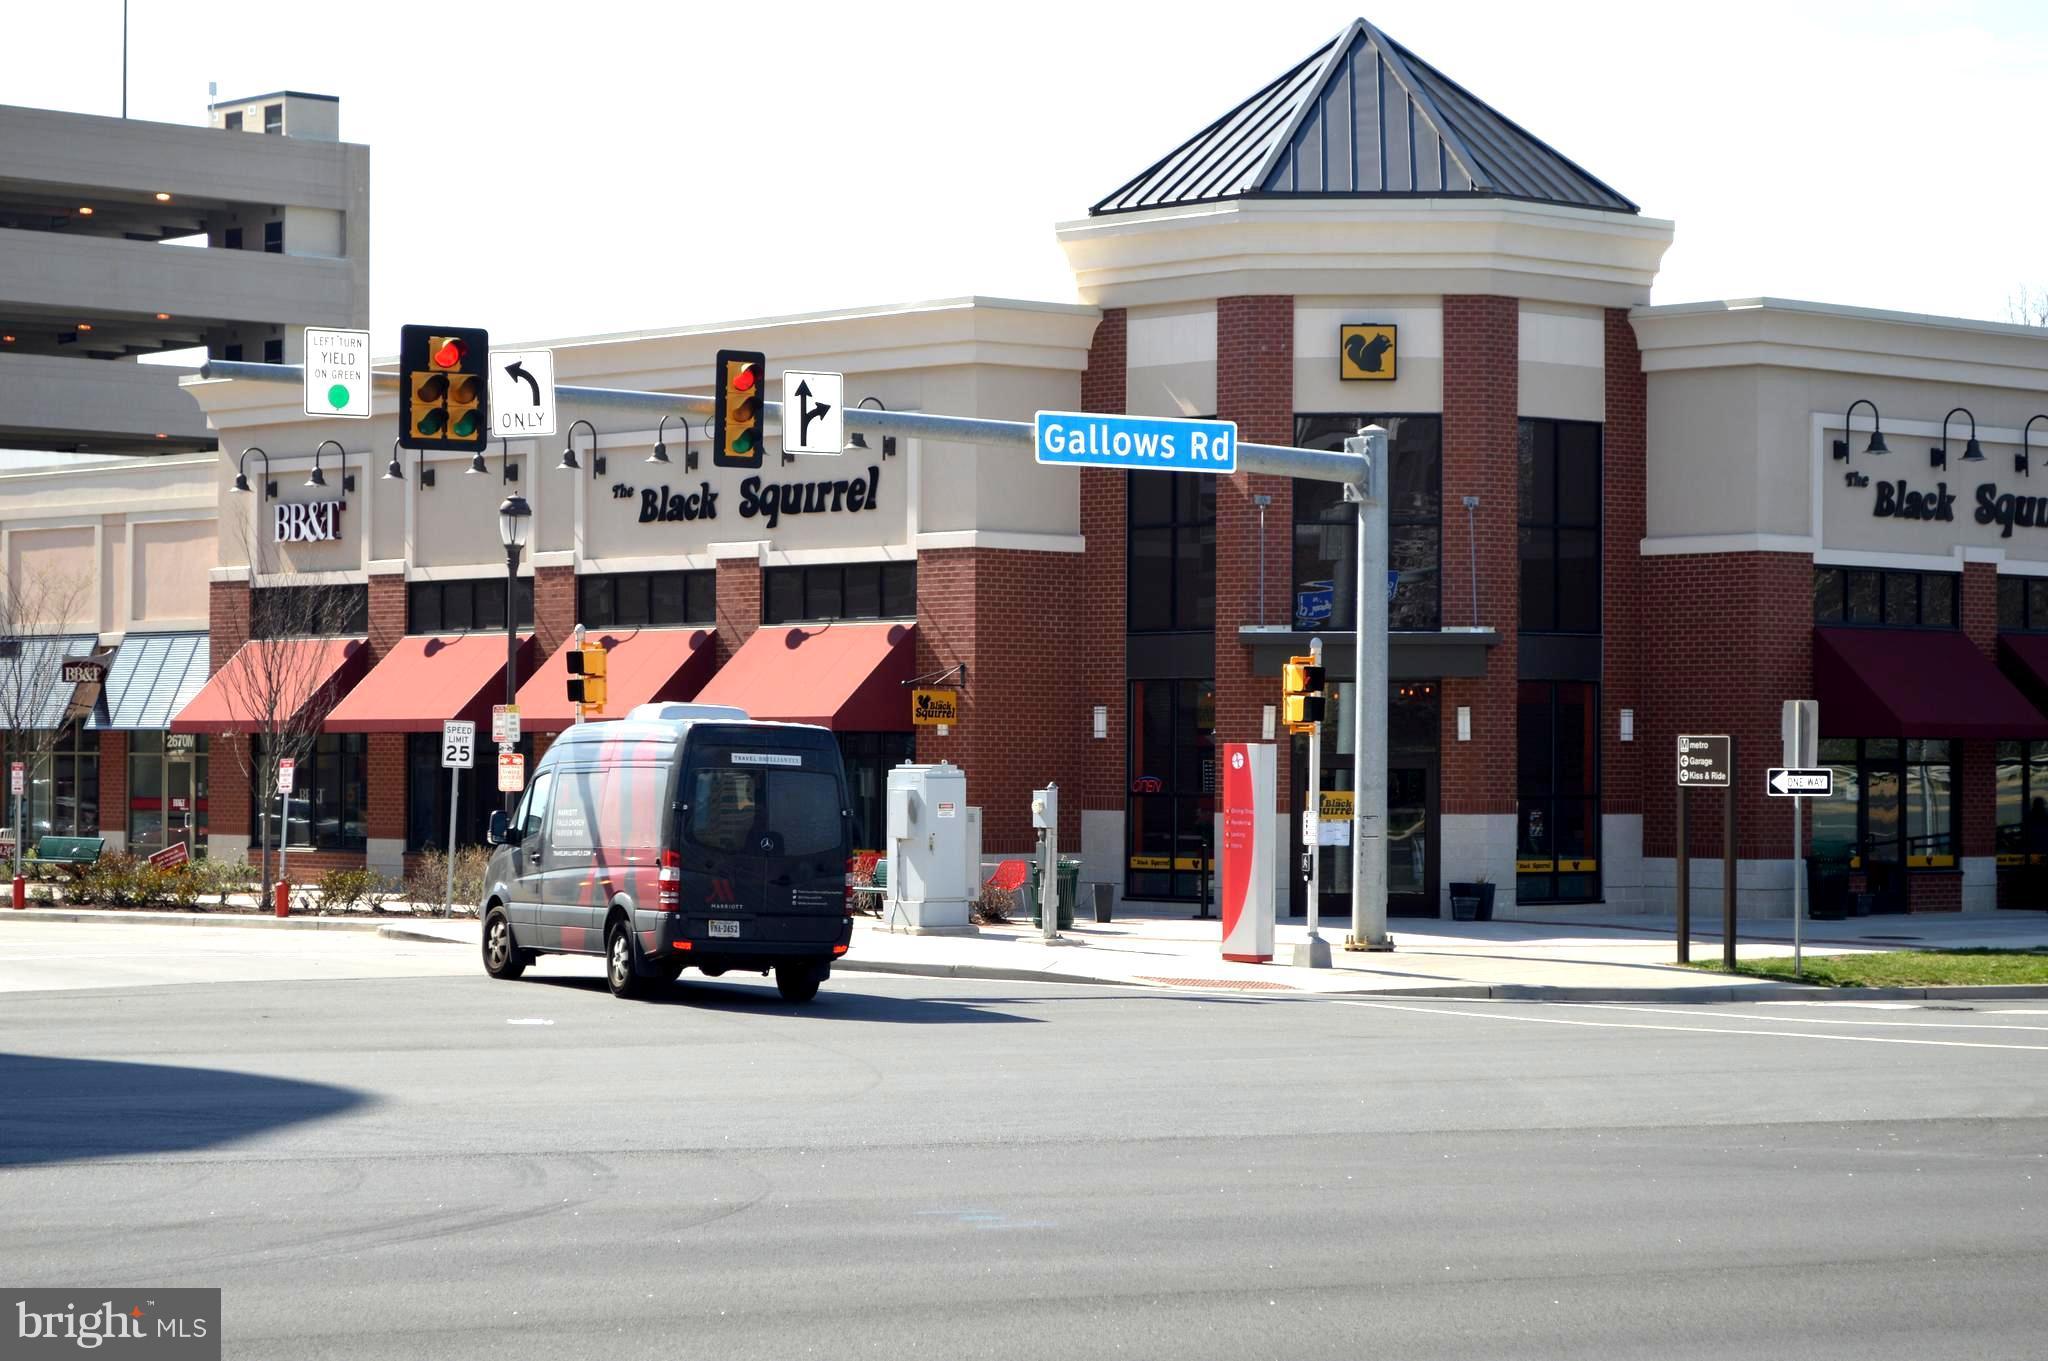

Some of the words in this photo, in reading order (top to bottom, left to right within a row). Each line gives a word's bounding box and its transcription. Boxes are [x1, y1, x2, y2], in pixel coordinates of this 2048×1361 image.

[313, 336, 335, 347] LEFT
[339, 336, 363, 348] TURN
[321, 351, 356, 366] YIELD
[314, 368, 328, 379] ON
[331, 370, 361, 381] GREEN
[501, 412, 546, 429] ONLY
[1044, 423, 1176, 459] Gallows
[1190, 431, 1230, 462] Rd
[612, 483, 635, 499] The
[638, 481, 719, 523] Black
[738, 465, 880, 529] Squirrel
[1845, 471, 1870, 488] The
[1873, 479, 1957, 522] Black
[272, 500, 346, 543] BB&T
[65, 666, 102, 682] BB&T
[930, 701, 952, 711] Black
[915, 707, 955, 721] Squirrel
[446, 726, 472, 735] SPEED
[1689, 741, 1709, 749] metro
[446, 745, 470, 762] 25
[734, 754, 758, 763] TRAVEL
[1689, 756, 1713, 767] Garage
[1689, 771, 1704, 780] Kiss
[1704, 771, 1710, 780] &
[1711, 771, 1726, 780] Ride
[1787, 777, 1804, 787] ONE
[1807, 777, 1824, 787] WAY
[1133, 780, 1162, 793] OPEN
[1325, 799, 1353, 808] Black
